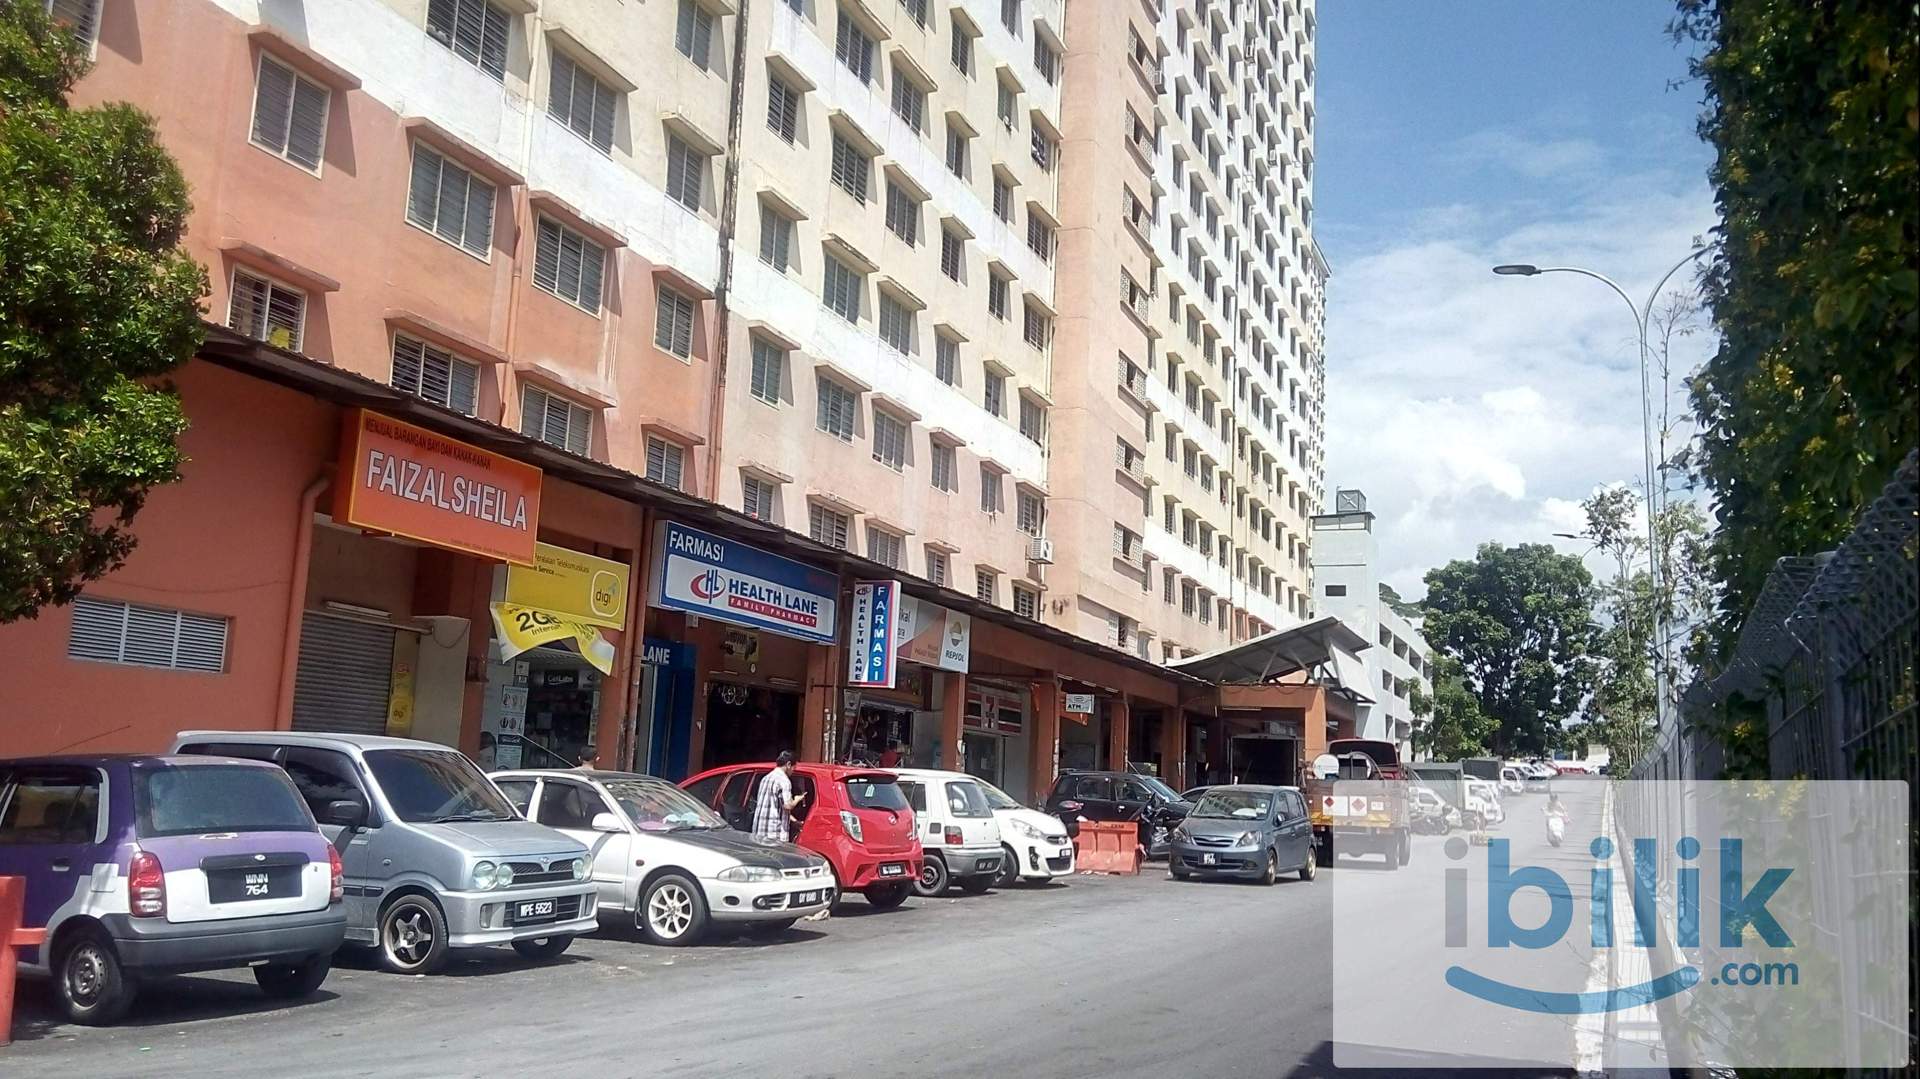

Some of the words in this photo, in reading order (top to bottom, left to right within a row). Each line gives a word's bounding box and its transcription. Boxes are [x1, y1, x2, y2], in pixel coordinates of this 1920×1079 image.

[394, 427, 426, 449] BARANGAN
[669, 530, 724, 563] FARMASI
[595, 589, 611, 606] digi
[729, 578, 782, 606] HEALTH
[785, 593, 818, 616] LANE
[730, 597, 766, 613] FAMILY
[770, 606, 816, 625] PHARMACY
[855, 598, 867, 645] HEALTH
[872, 586, 886, 681] FARMASI
[854, 649, 863, 681] LANE
[945, 650, 965, 662] REPSOL
[245, 884, 269, 896] 764
[535, 901, 553, 915] 5523
